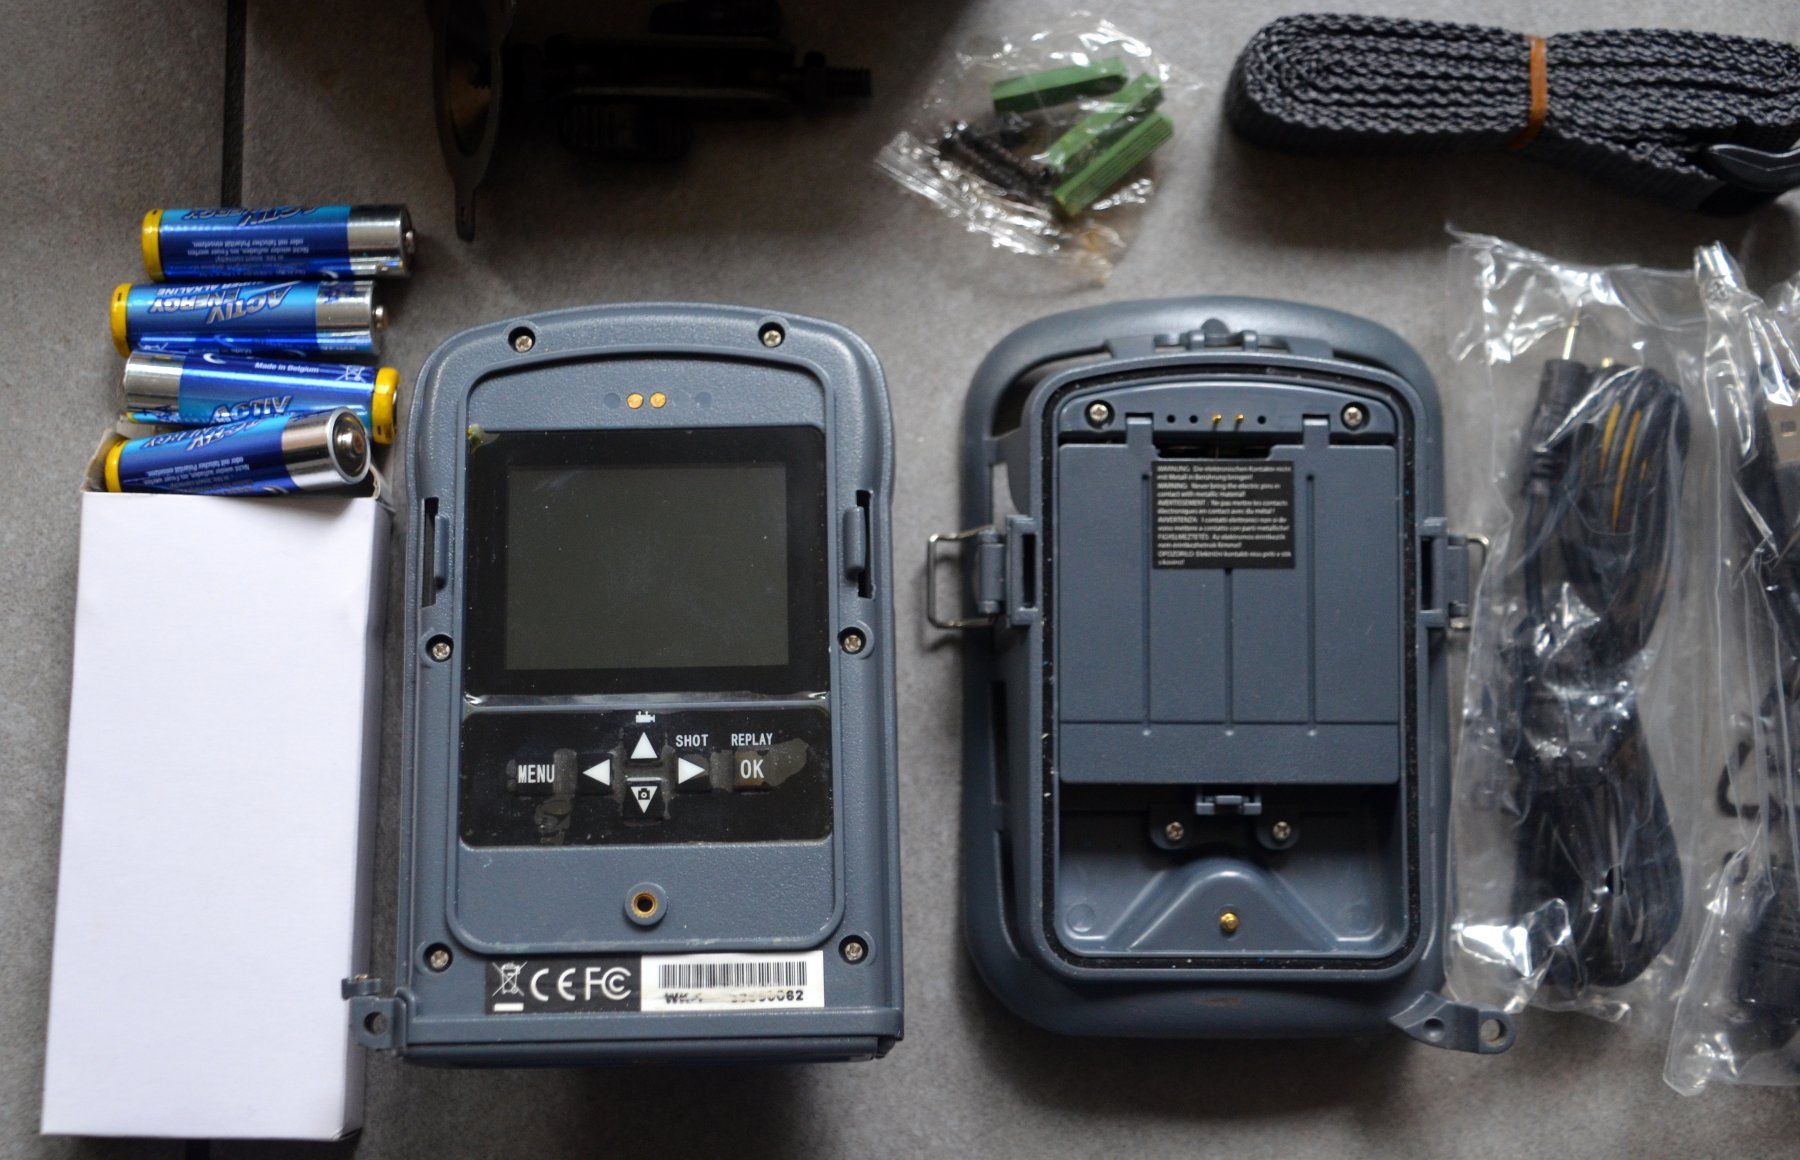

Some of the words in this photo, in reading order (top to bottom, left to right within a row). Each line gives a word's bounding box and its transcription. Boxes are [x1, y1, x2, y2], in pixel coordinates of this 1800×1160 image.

[157, 284, 220, 295] ALKALINE
[149, 287, 241, 313] ENERGY
[206, 286, 293, 324] ACTIV
[254, 362, 277, 370] Made
[277, 363, 286, 371] in
[287, 364, 320, 373] Belgium
[675, 733, 709, 747] SHOT
[731, 733, 773, 746] REPLAY
[518, 764, 556, 783] MENU
[740, 759, 765, 779] OK
[530, 968, 577, 1001] CE
